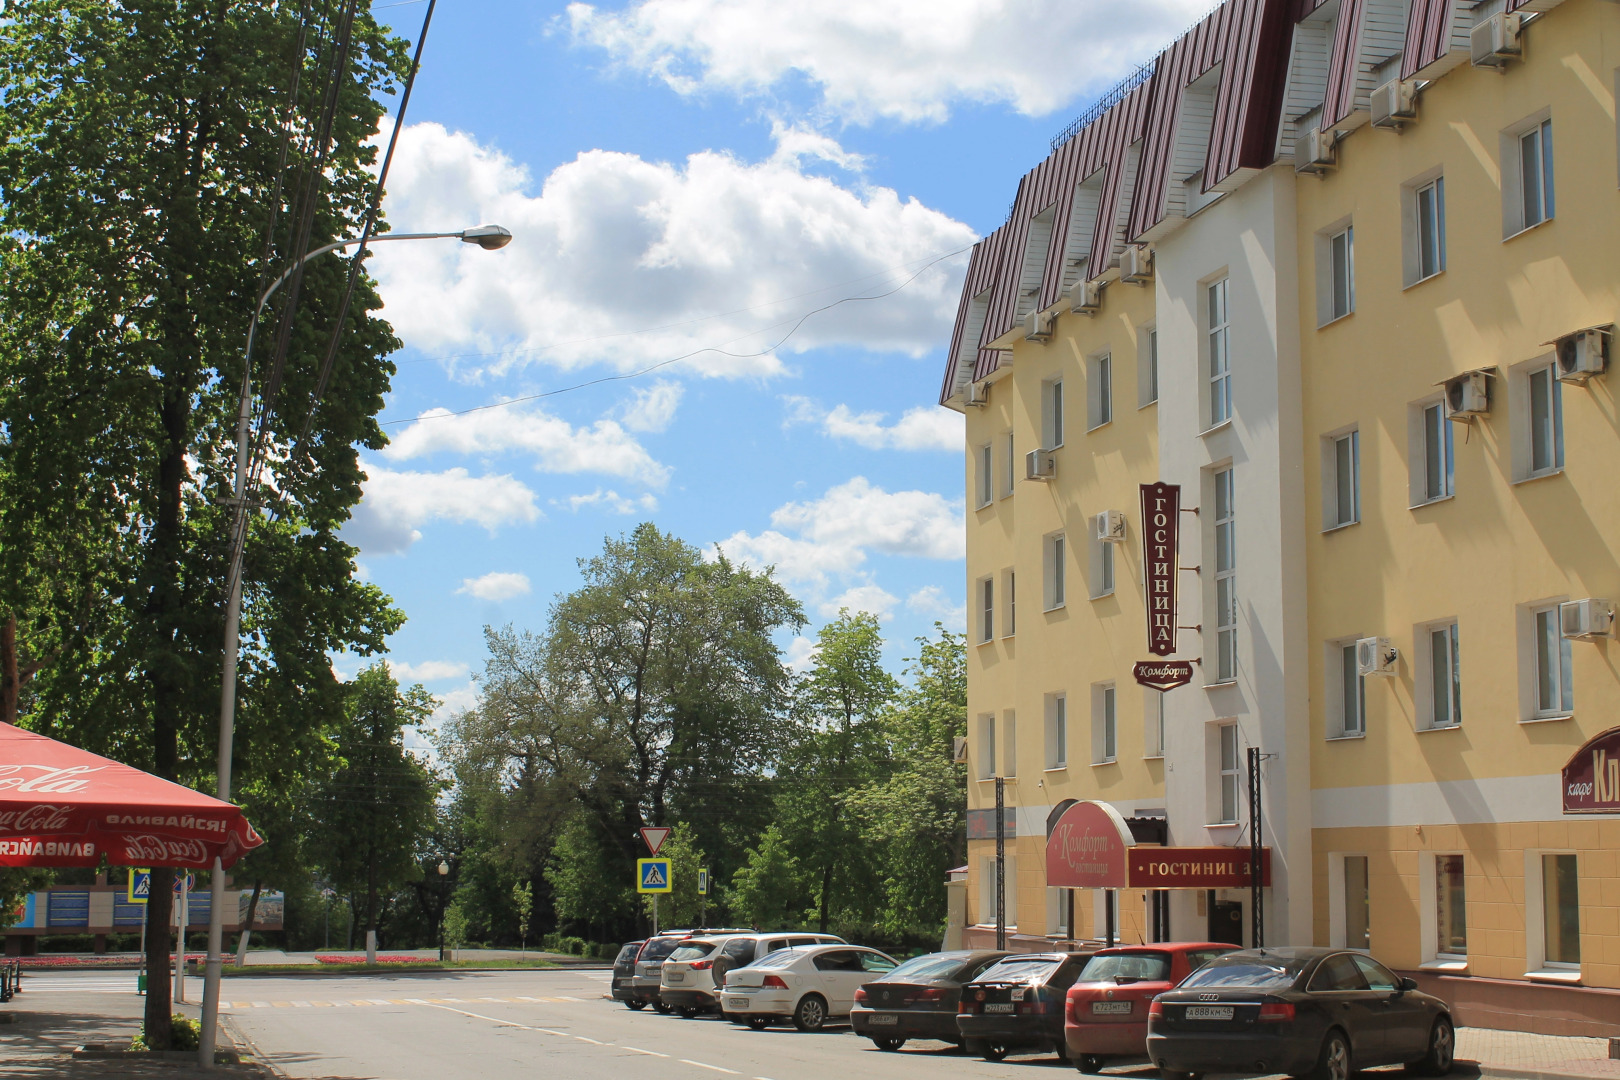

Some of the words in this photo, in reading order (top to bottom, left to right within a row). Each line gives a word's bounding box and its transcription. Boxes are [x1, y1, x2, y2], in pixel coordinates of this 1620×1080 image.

[1153, 498, 1170, 641] ГОСТИНИЦА
[1138, 664, 1189, 679] Комфорт
[106, 814, 227, 833] ВЛИВАЙСЯ!
[1059, 823, 1108, 868] Комфорт
